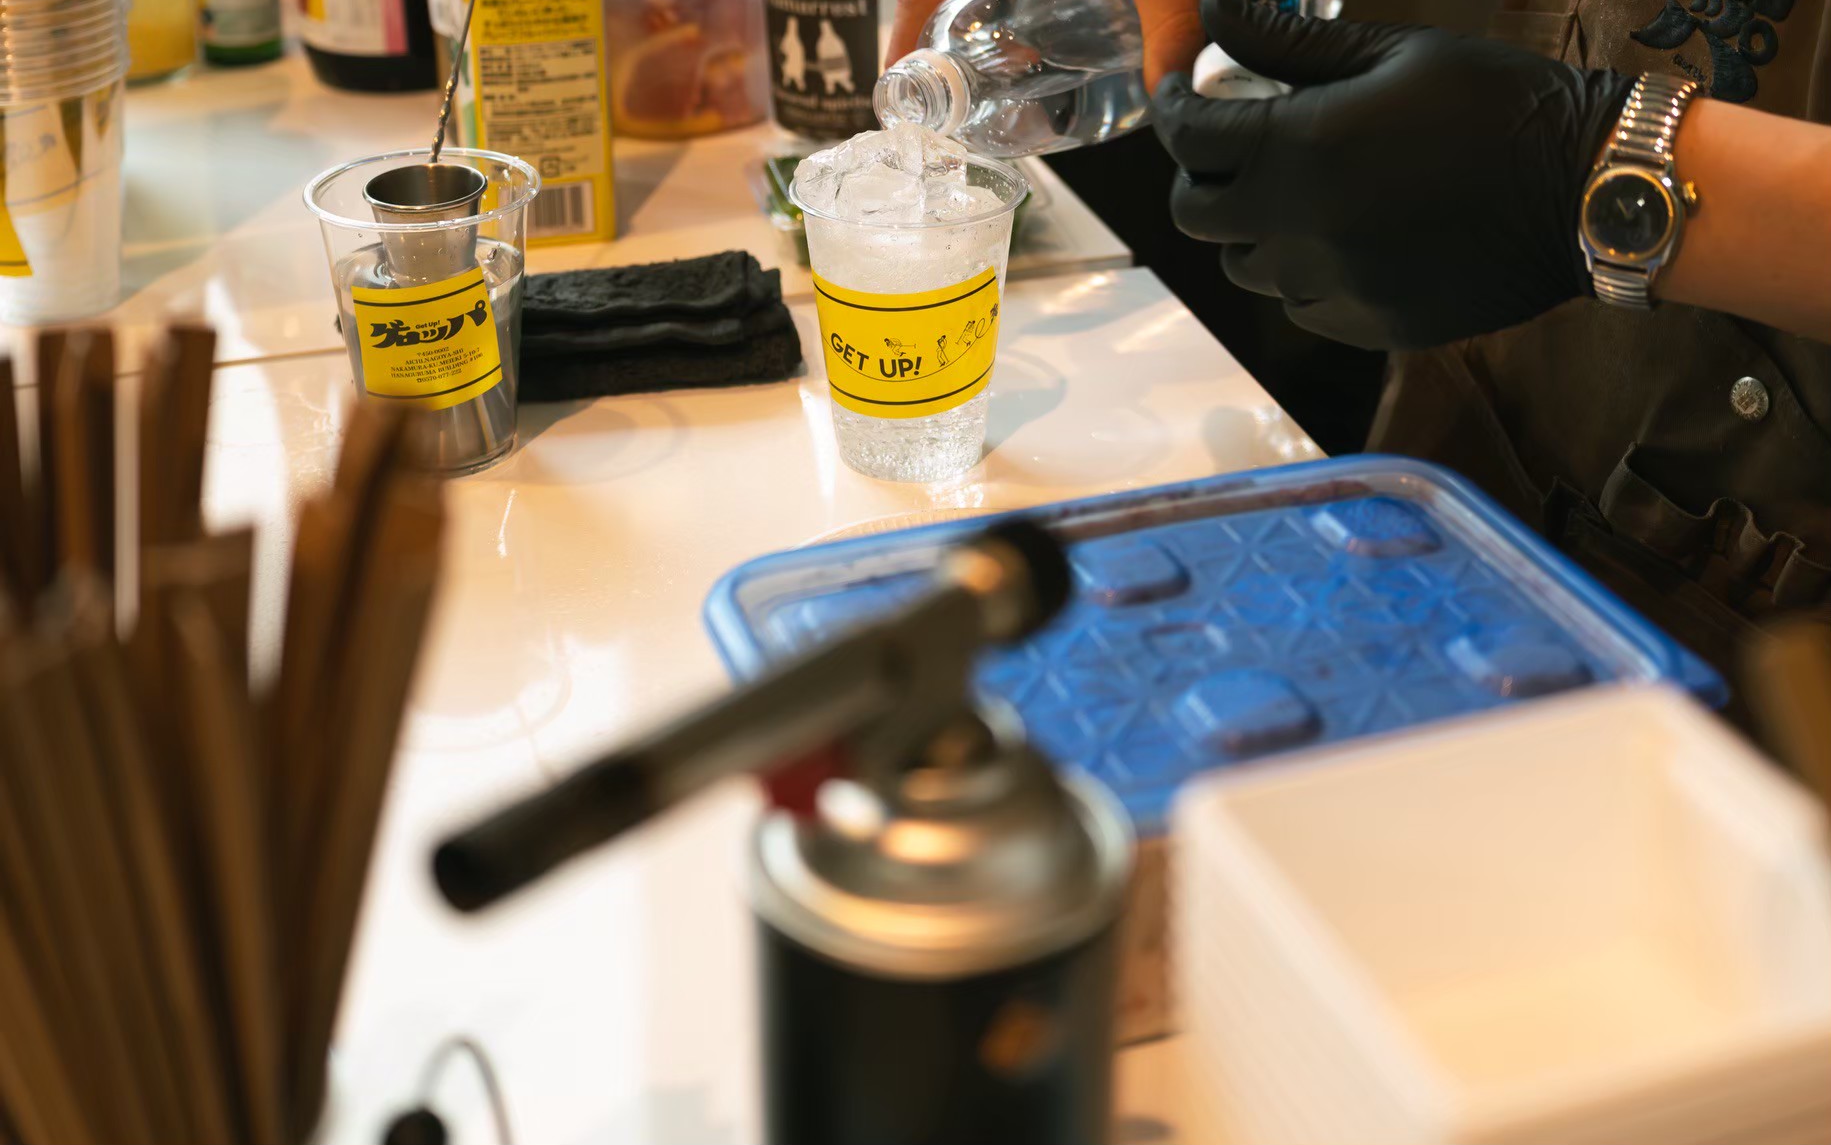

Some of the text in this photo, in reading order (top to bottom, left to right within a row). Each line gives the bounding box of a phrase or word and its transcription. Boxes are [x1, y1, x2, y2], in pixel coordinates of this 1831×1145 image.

[415, 320, 441, 330] Get Up!
[830, 332, 922, 378] GET UP!
